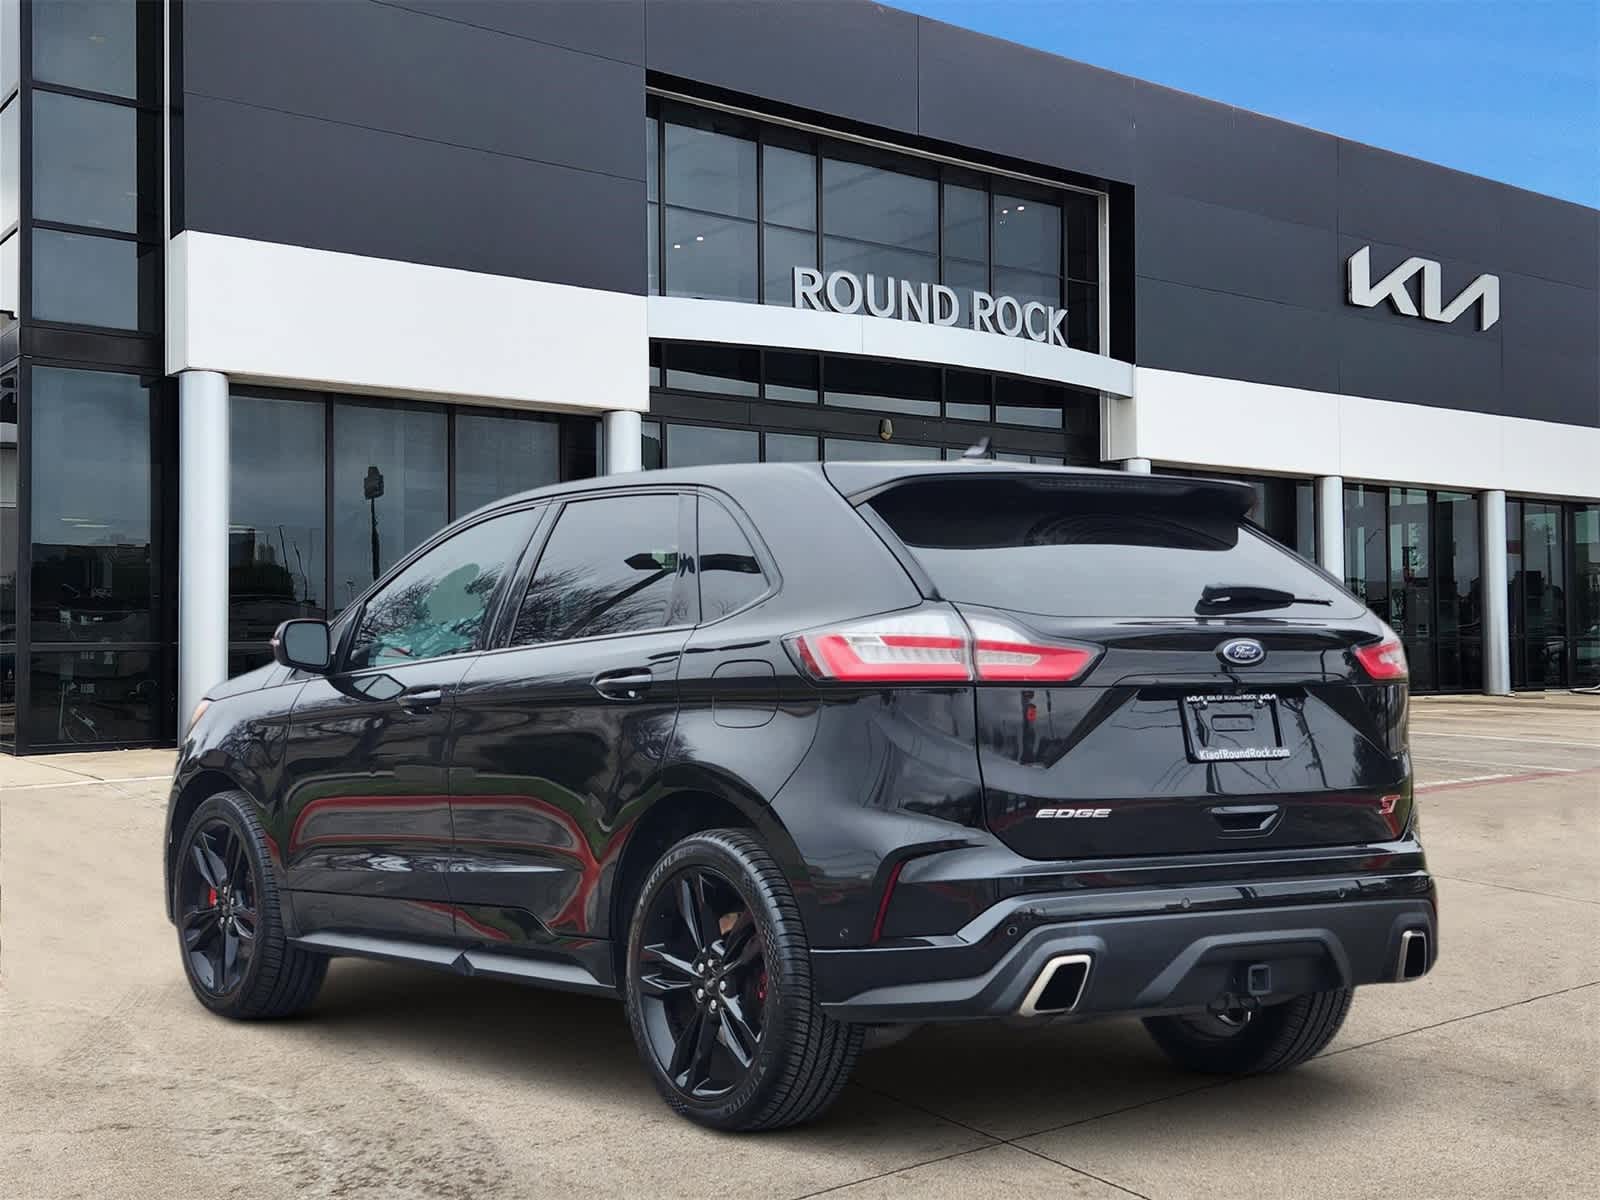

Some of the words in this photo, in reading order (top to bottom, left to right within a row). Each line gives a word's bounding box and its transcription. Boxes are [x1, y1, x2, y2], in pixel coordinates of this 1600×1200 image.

[792, 266, 960, 327] ROUND
[970, 290, 1069, 348] ROCK
[1348, 245, 1500, 331] KIA
[1234, 645, 1257, 658] Ford
[1035, 808, 1112, 818] EDGE
